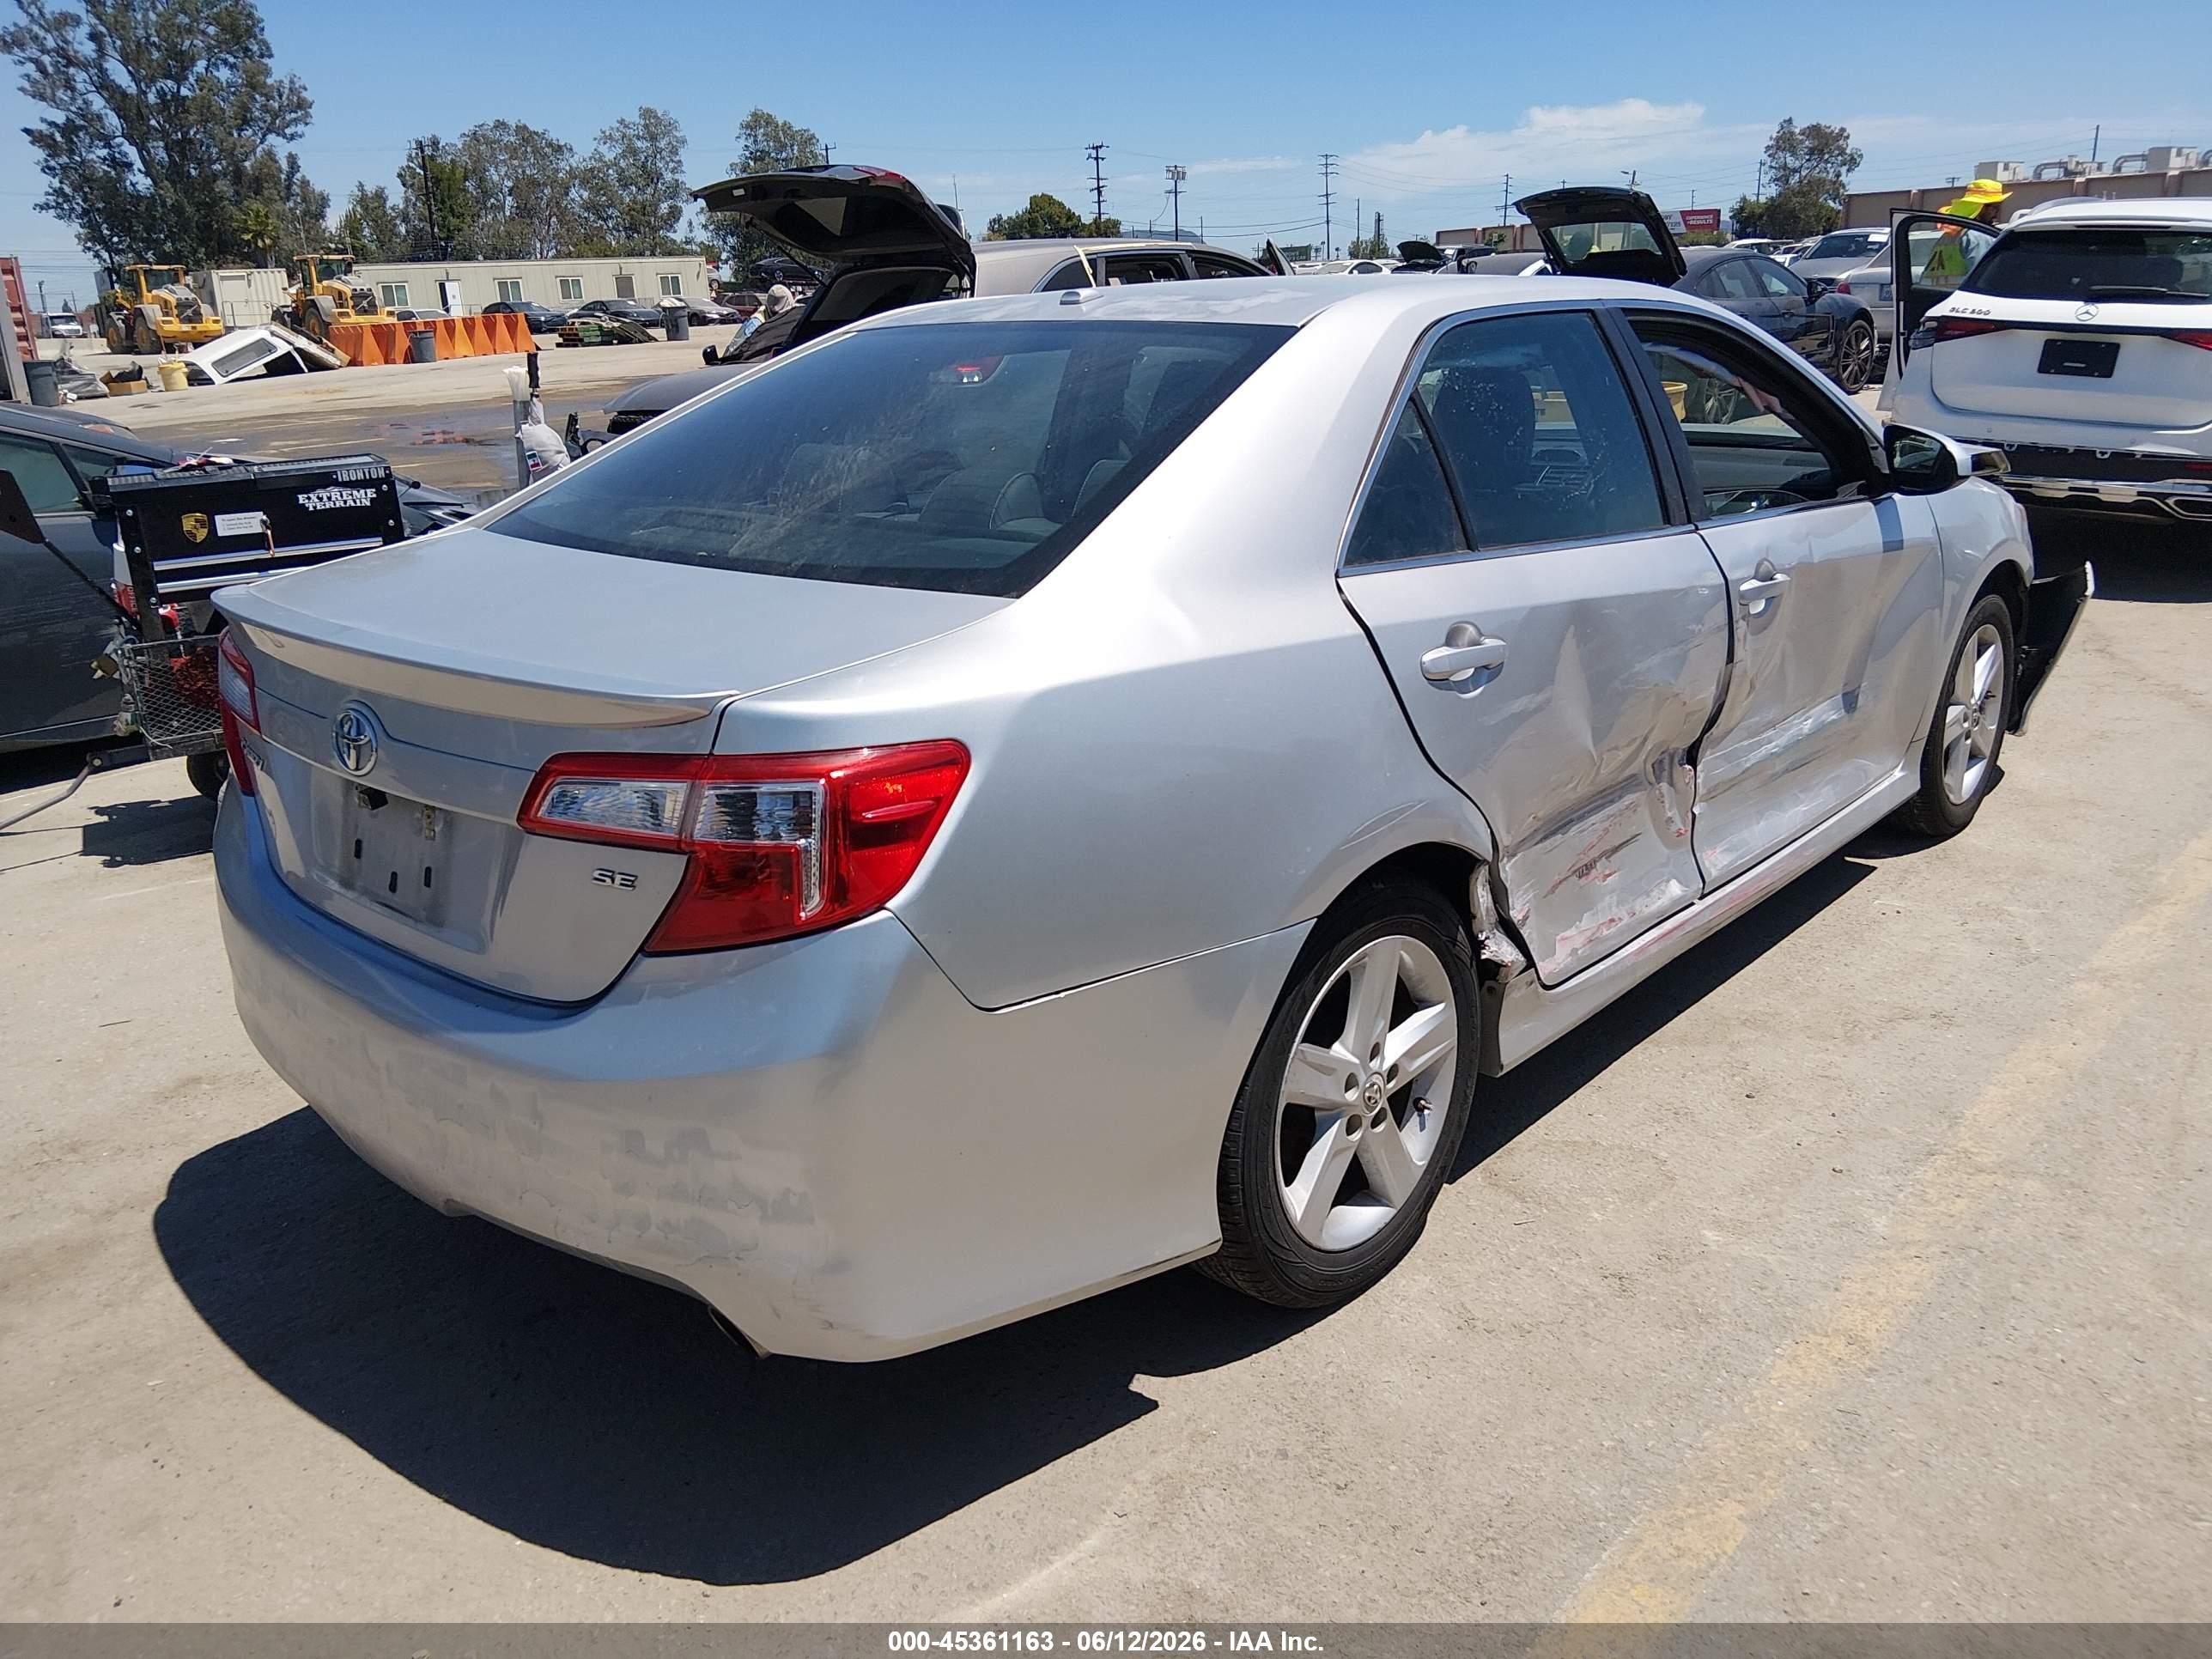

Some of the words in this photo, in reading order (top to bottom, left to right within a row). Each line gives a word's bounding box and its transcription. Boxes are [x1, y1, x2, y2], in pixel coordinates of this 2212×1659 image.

[337, 466, 386, 482] IRONTON
[297, 488, 377, 504] EXTREME
[305, 498, 372, 511] TERRAIN
[591, 867, 639, 891] SE
